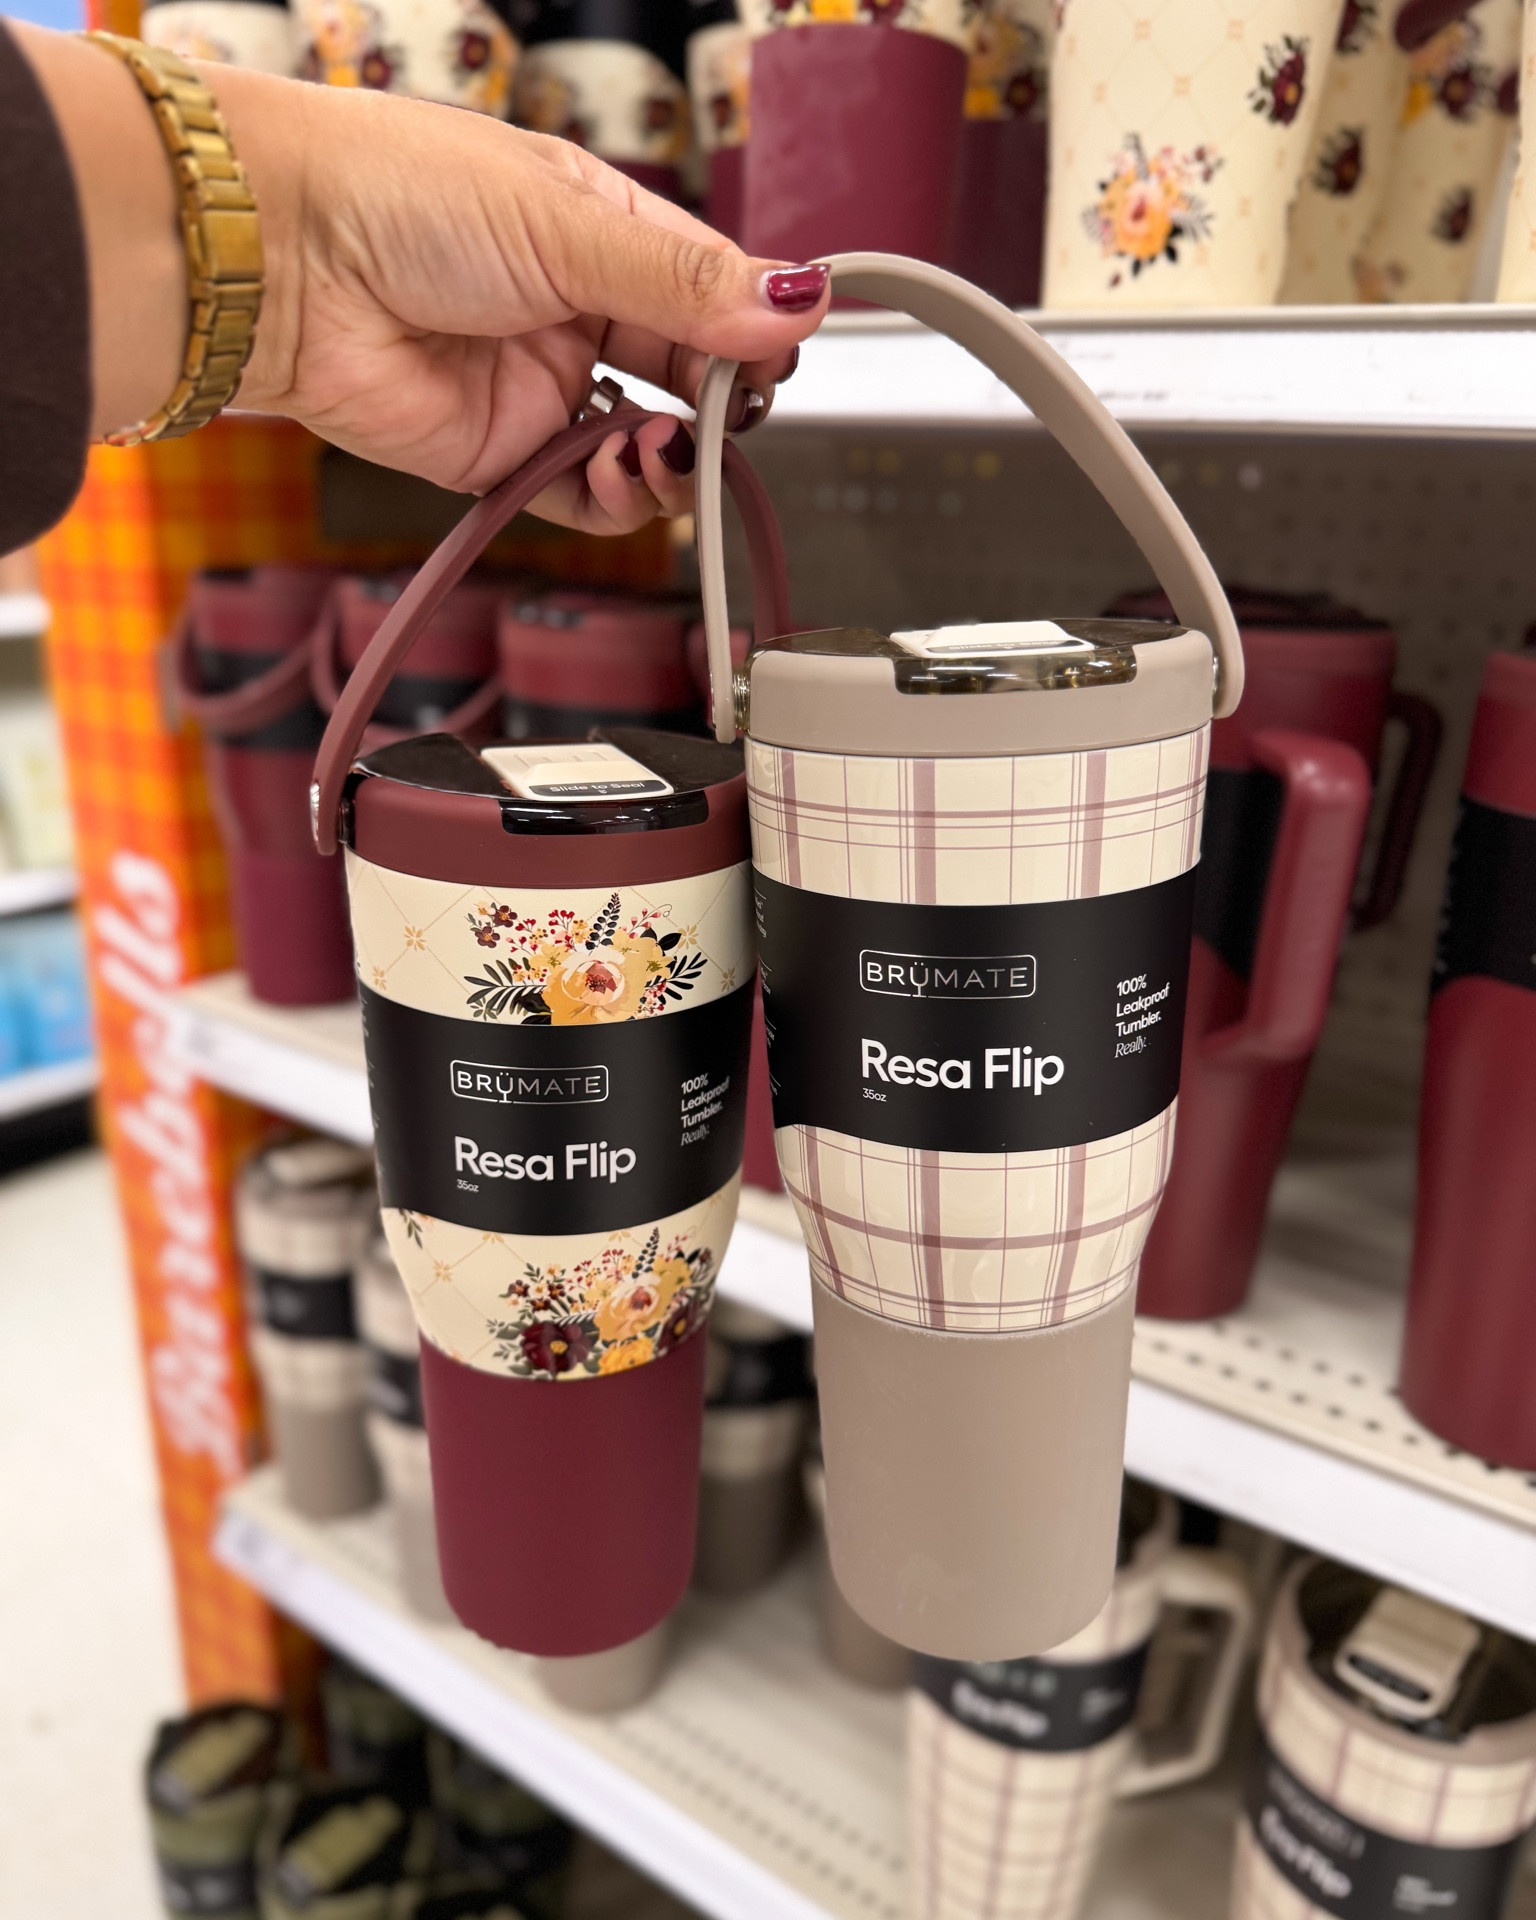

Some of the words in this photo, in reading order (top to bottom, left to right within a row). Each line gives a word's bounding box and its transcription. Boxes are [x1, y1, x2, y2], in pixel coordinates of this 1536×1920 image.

[549, 783, 588, 793] Slide
[591, 782, 608, 791] to
[610, 781, 646, 790] Seal
[1116, 973, 1147, 997] 100%
[1115, 982, 1170, 1018] Leakproof
[1115, 1011, 1162, 1037] Tumbler.
[1114, 1035, 1147, 1059] Really.
[861, 1037, 971, 1089] Resa
[984, 1045, 1065, 1096] Flip
[681, 1072, 709, 1095] 100%
[681, 1075, 730, 1113] Leakproof
[862, 1087, 887, 1102] 35oz
[680, 1101, 723, 1129] Tumbler.
[454, 1135, 554, 1182] Resa
[565, 1140, 637, 1184] Flip
[456, 1178, 480, 1193] 35oz
